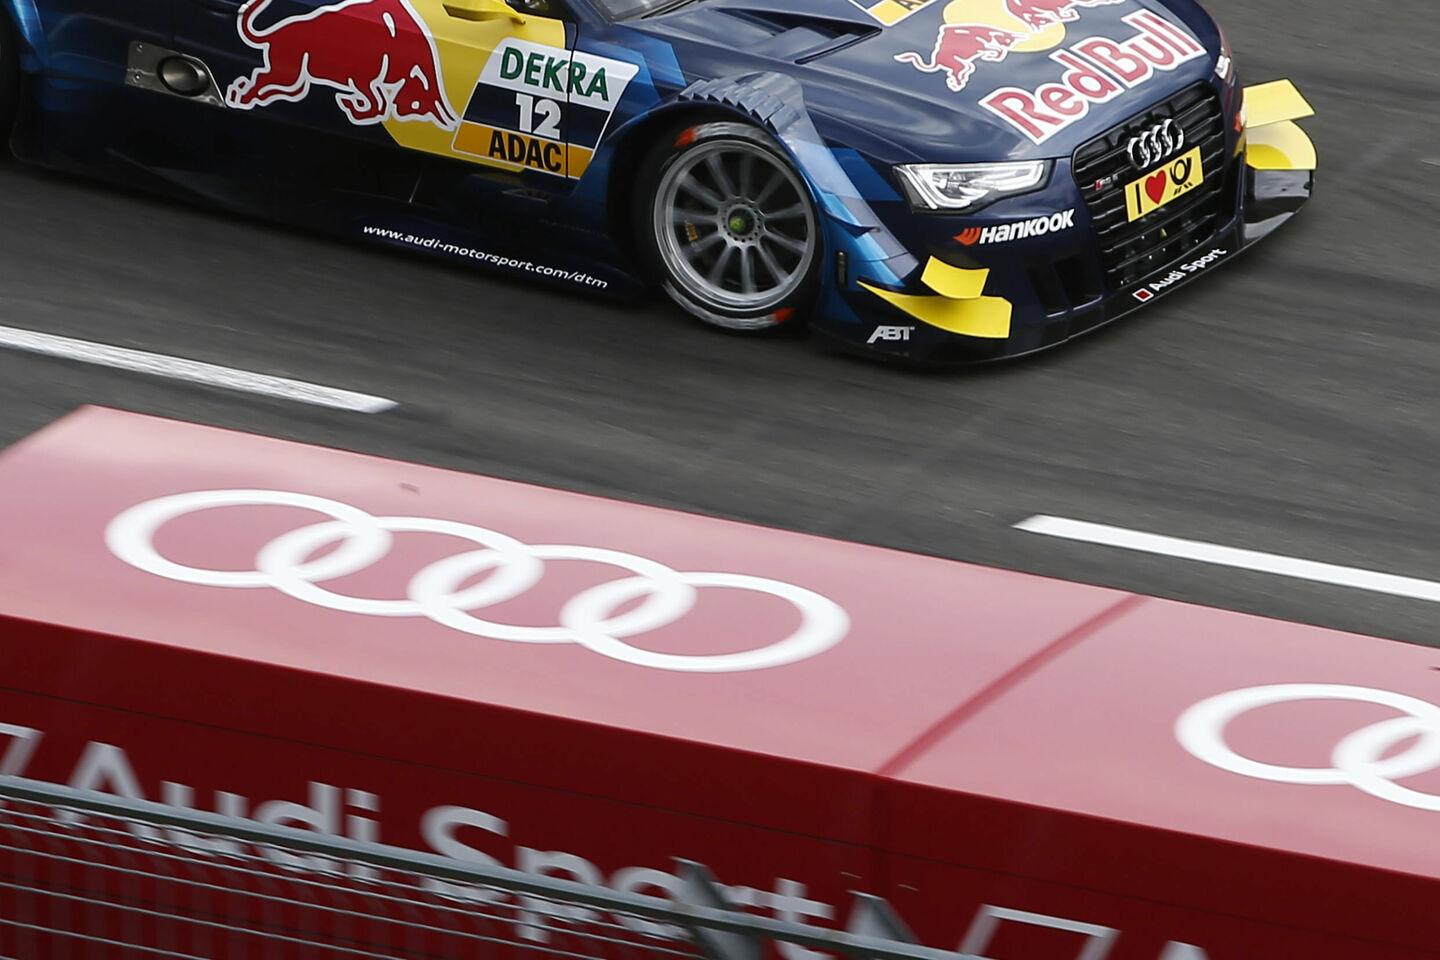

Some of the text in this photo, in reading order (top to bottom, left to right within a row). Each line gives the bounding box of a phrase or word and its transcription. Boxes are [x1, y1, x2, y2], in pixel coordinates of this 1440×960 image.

[500, 46, 609, 102] DEKRA
[515, 93, 562, 140] 12
[488, 130, 562, 172] ADAC
[1135, 183, 1142, 214] I
[363, 225, 608, 289] www.audi-motorsport.com/dtm
[1149, 248, 1227, 291] Audi Sport
[866, 325, 915, 343] ABT
[52, 740, 381, 886] Audi
